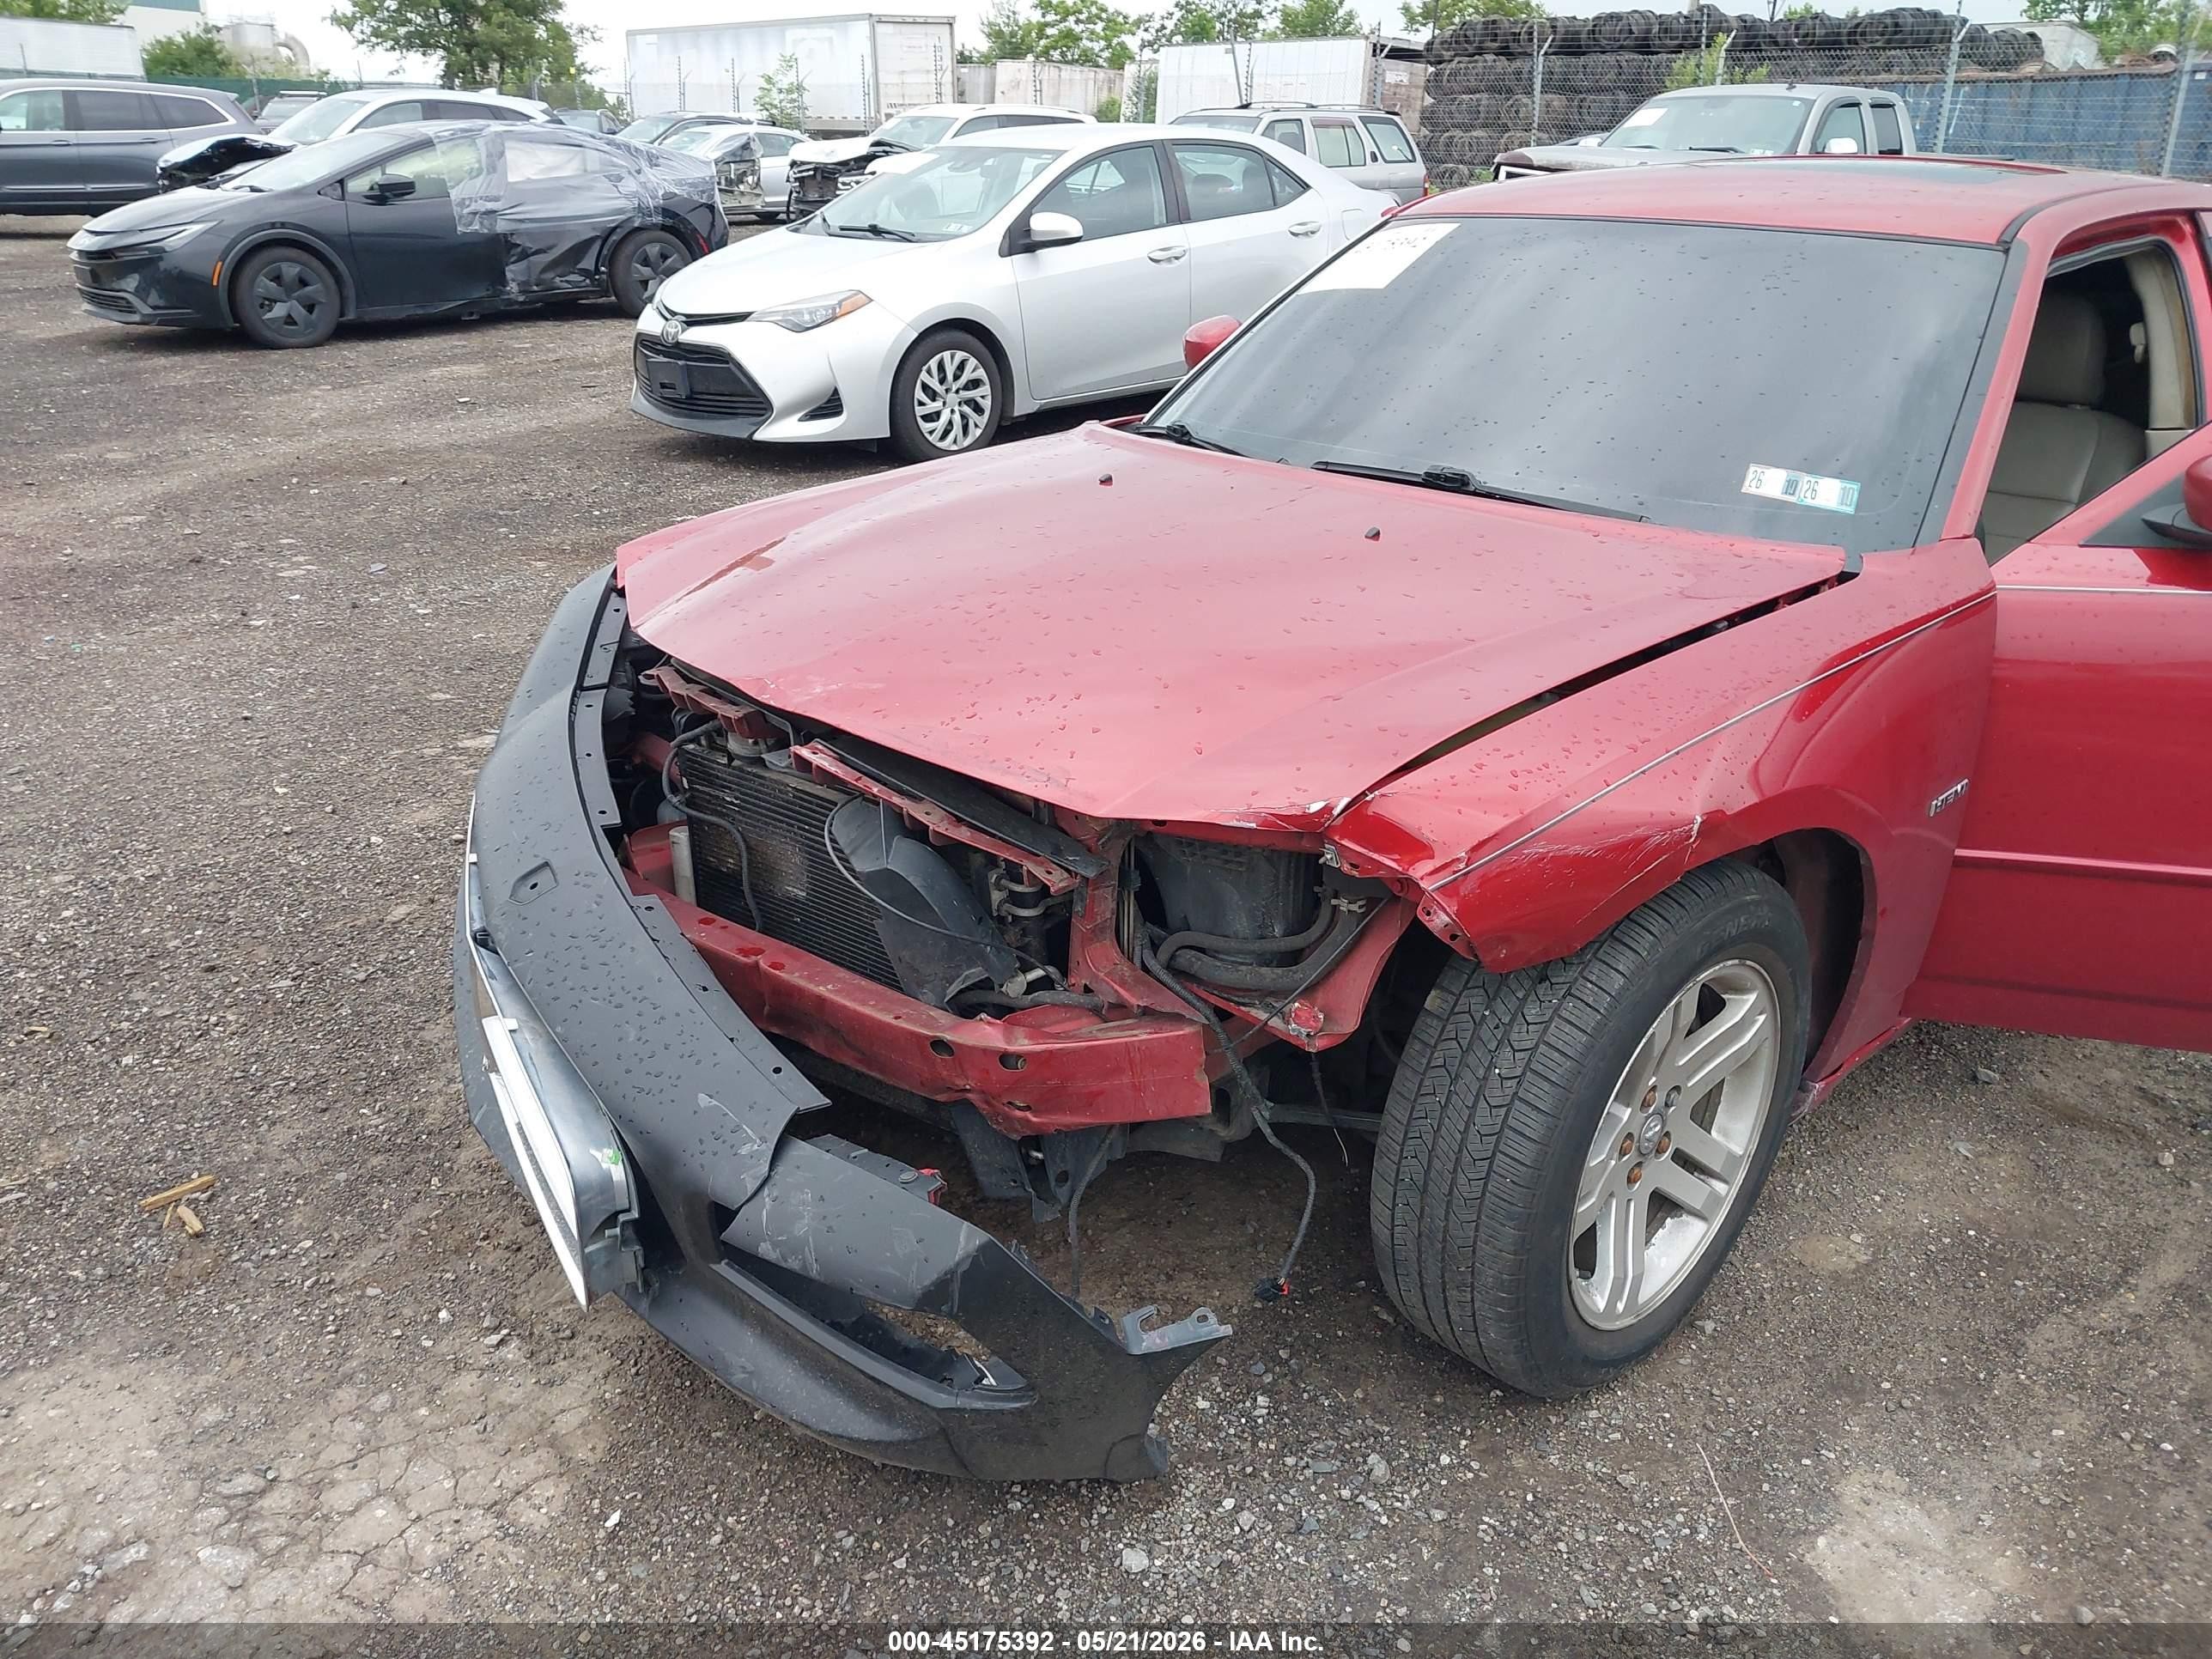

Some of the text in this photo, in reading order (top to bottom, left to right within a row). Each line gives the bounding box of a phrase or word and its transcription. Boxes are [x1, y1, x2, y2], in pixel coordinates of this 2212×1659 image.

[1748, 470, 1765, 490] 26
[1802, 480, 1854, 506] 26 10
[1929, 778, 1969, 817] HEMI
